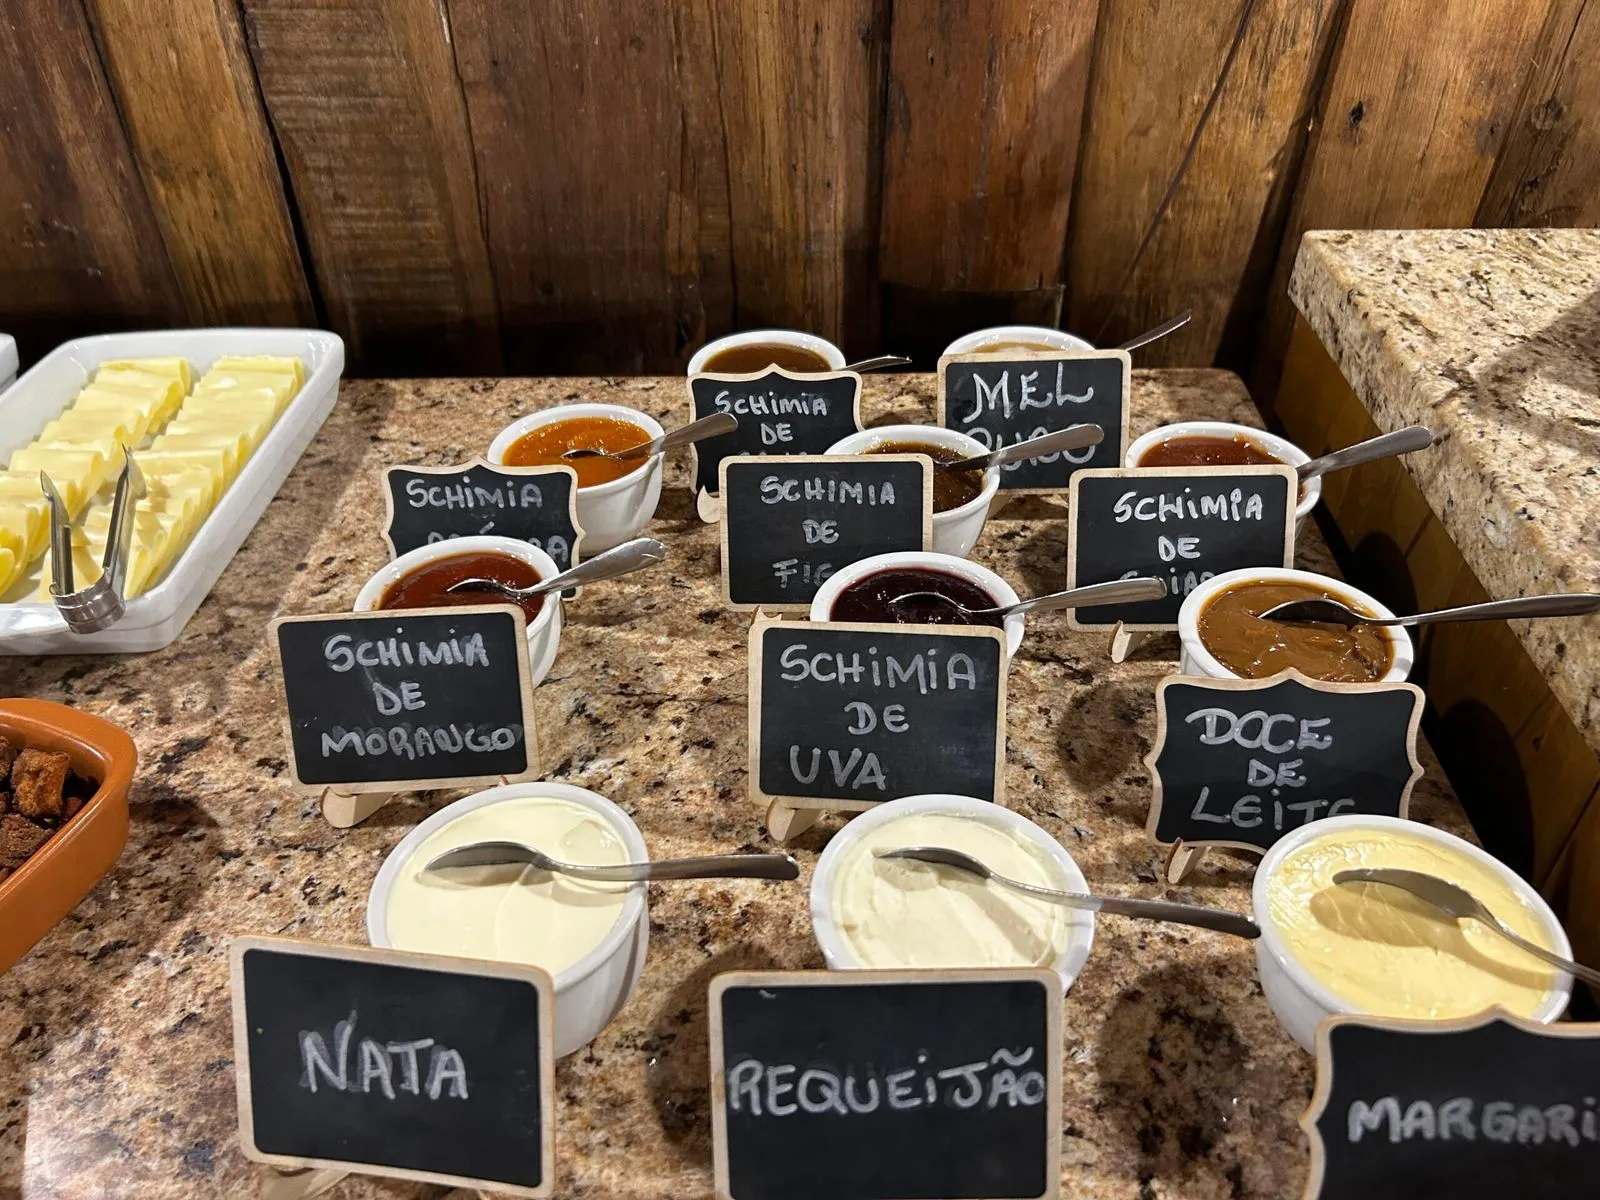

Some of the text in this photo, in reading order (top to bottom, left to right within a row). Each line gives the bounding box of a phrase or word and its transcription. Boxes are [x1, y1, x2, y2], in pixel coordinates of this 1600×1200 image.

[962, 361, 1094, 423] MEL
[760, 423, 794, 446] DE
[801, 518, 840, 545] DE
[1157, 535, 1201, 562] DE
[771, 557, 834, 589] FIG
[371, 681, 426, 716] DE
[843, 701, 910, 736] DE
[1184, 707, 1334, 755] DOCE
[321, 722, 516, 761] MORANGO
[789, 744, 887, 791] UVA
[1247, 758, 1308, 788] DE
[299, 1009, 469, 1101] NATA
[1347, 1096, 1600, 1148] MARGARi
